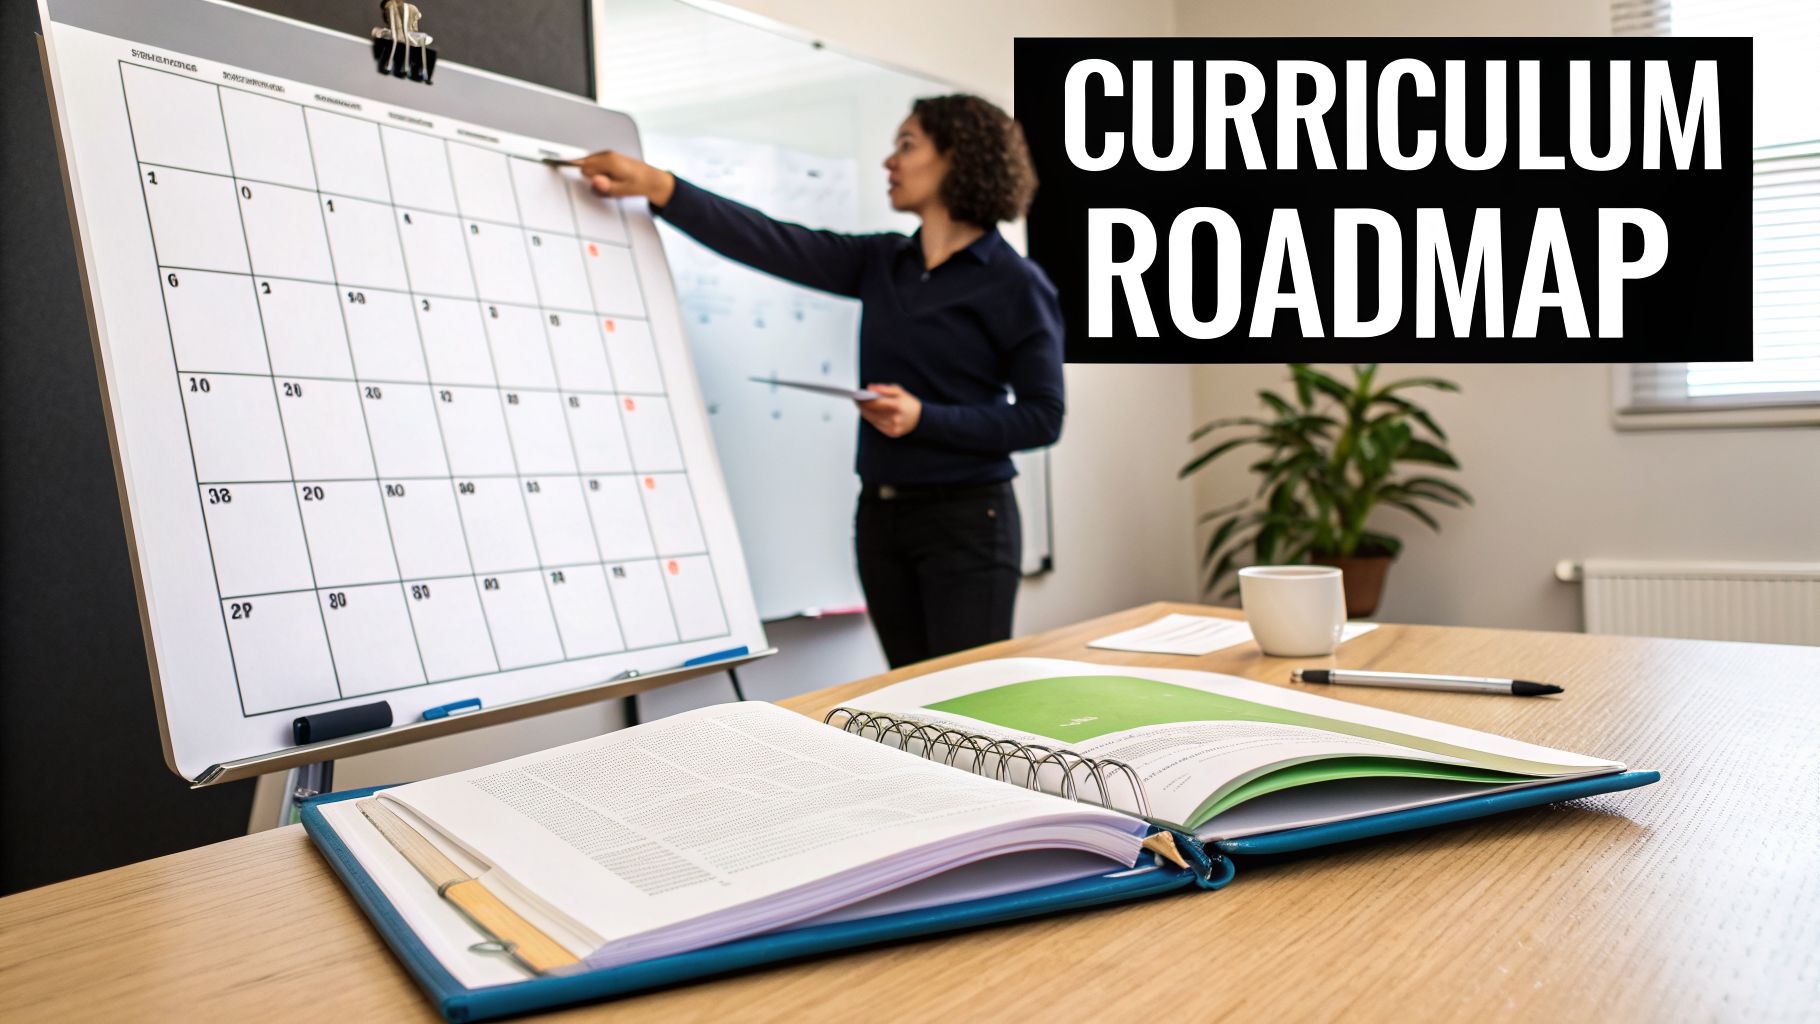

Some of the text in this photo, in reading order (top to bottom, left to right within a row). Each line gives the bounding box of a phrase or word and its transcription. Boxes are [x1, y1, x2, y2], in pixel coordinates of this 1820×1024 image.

[147, 171, 158, 185] 1
[241, 186, 252, 200] 0
[167, 273, 179, 288] 6
[302, 485, 325, 502] 20
